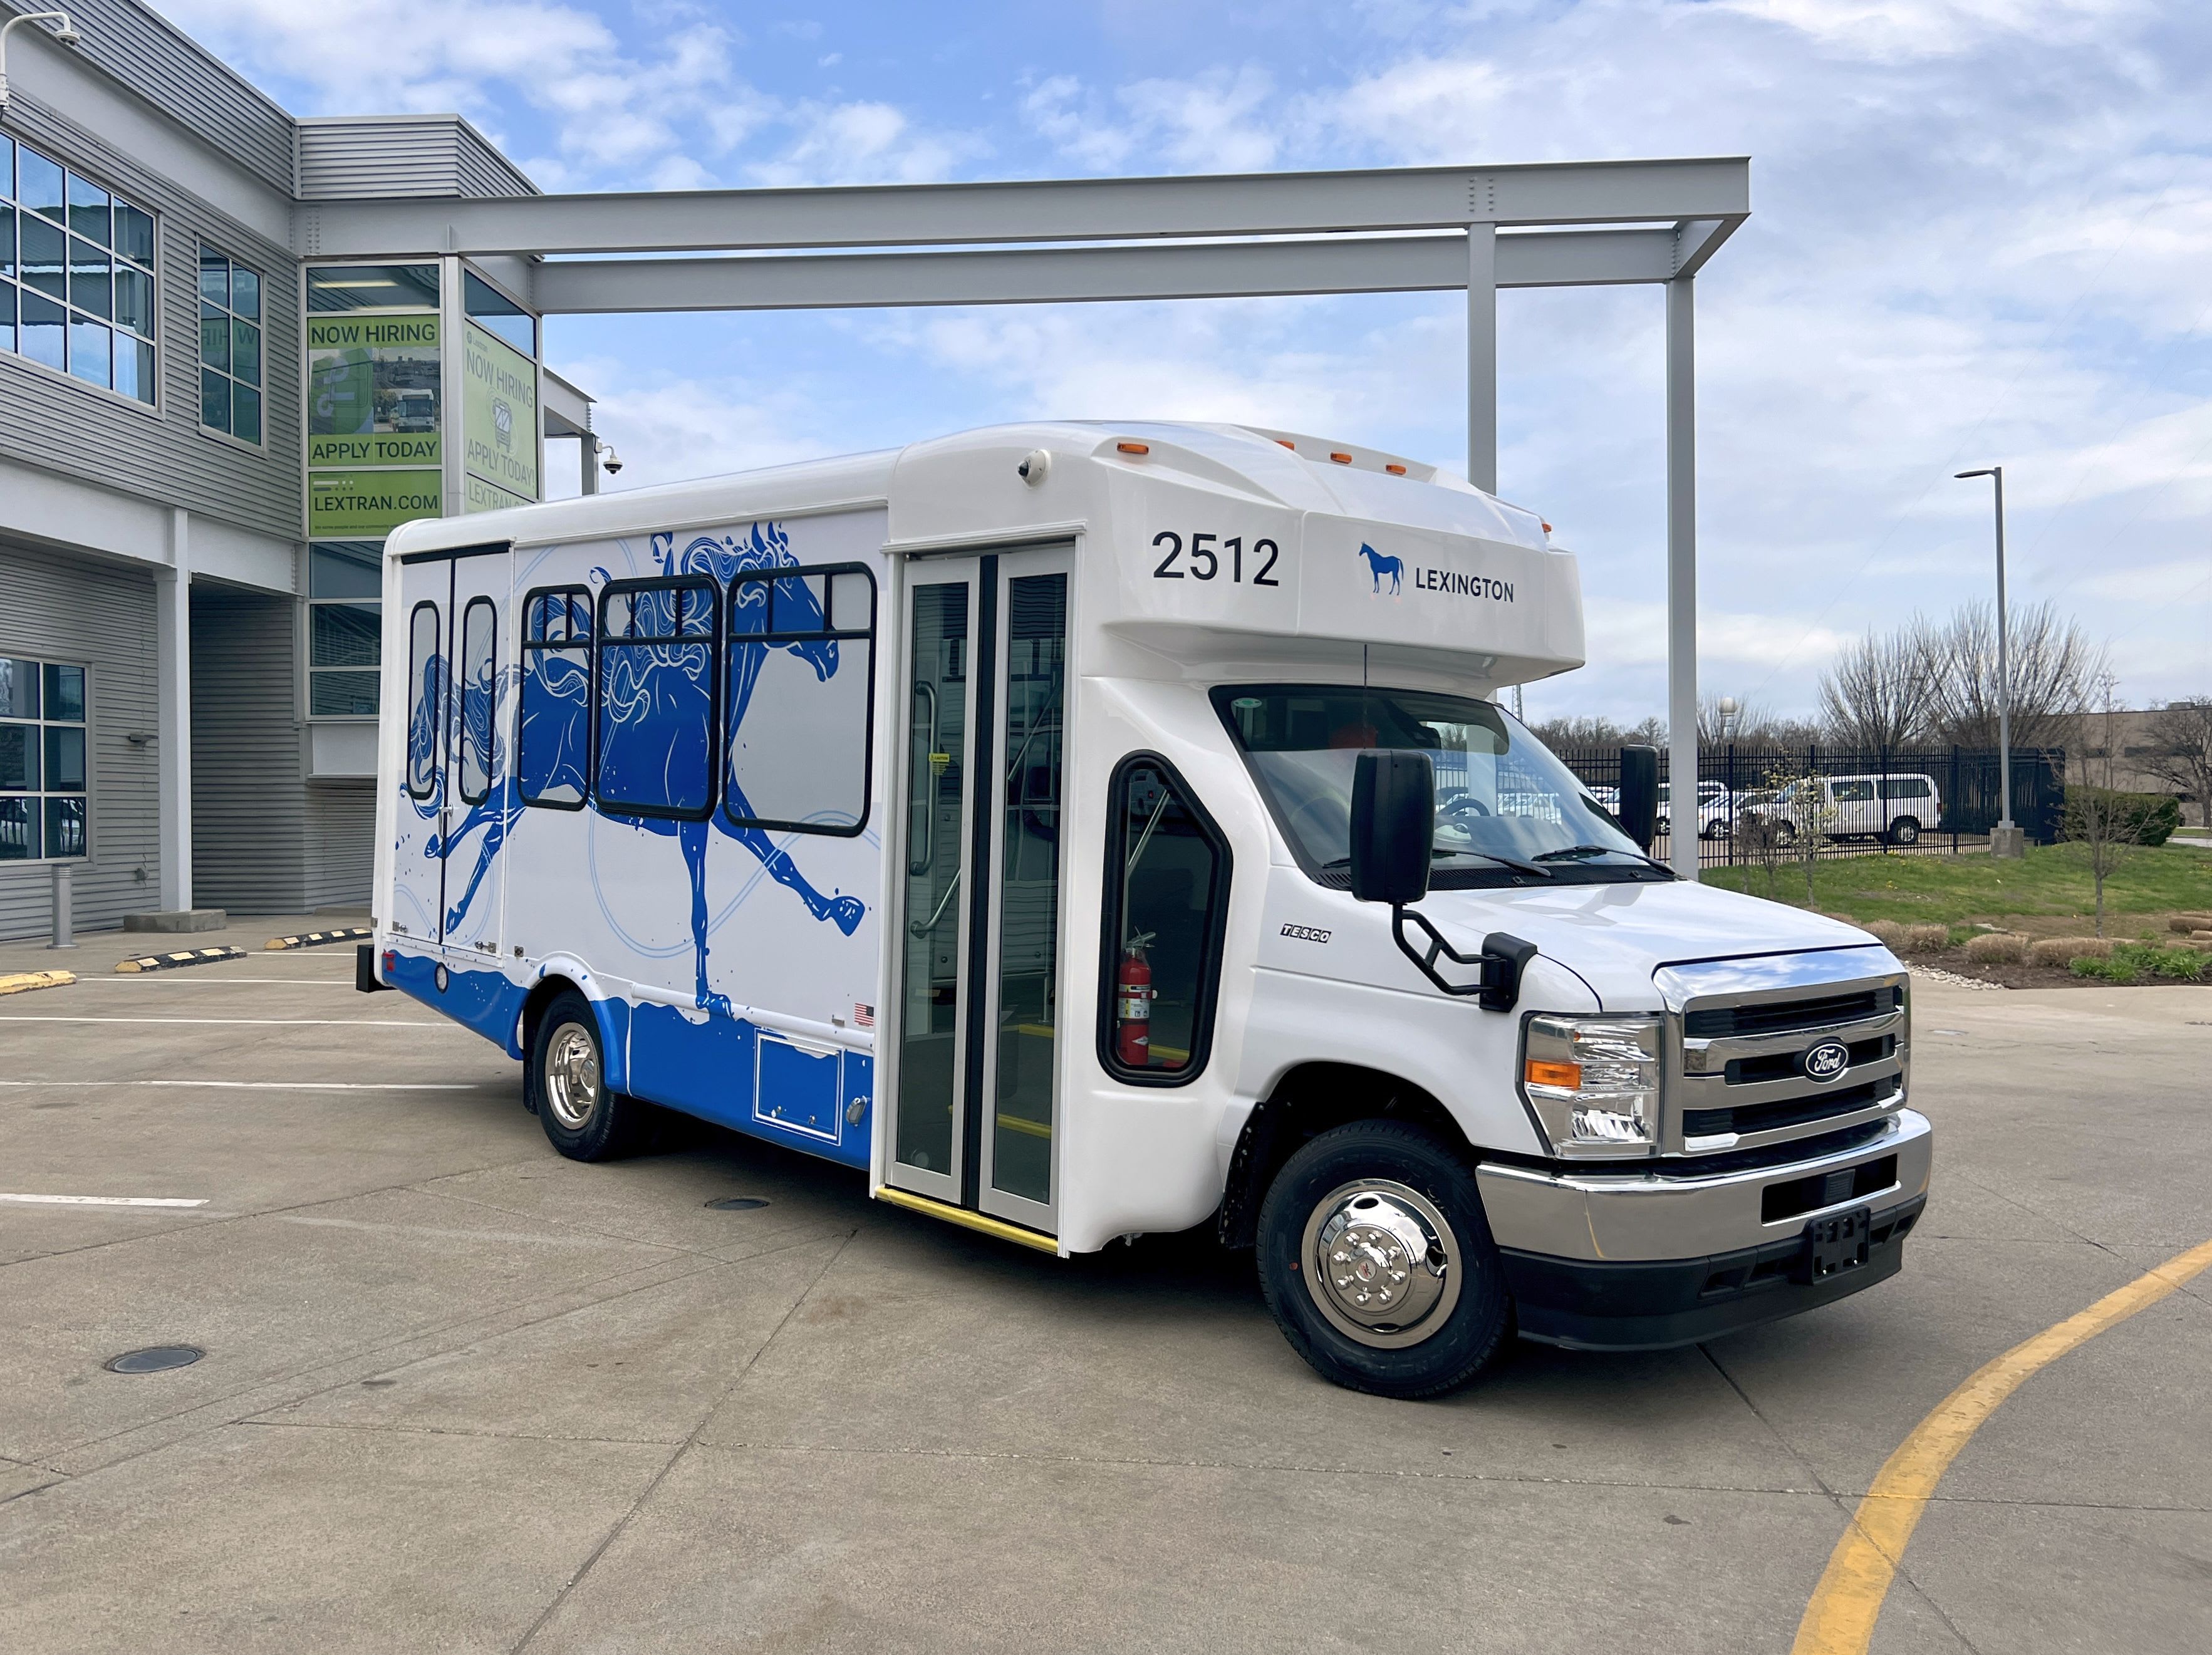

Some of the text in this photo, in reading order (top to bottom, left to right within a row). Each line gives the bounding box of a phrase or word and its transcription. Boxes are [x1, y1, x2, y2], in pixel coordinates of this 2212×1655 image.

[311, 324, 435, 343] NOW HIRING
[467, 348, 533, 408] NOW HIRING
[312, 441, 437, 459] APPLY TODAY
[467, 438, 534, 489] APPLY TODAY!
[314, 495, 438, 511] LEXTRAN.COM
[469, 480, 525, 510] LEXTRAN
[1151, 531, 1279, 587] 2512
[1415, 568, 1514, 603] LEXINGTON
[1282, 924, 1331, 943] TESCO
[1814, 1048, 1841, 1071] Ford
